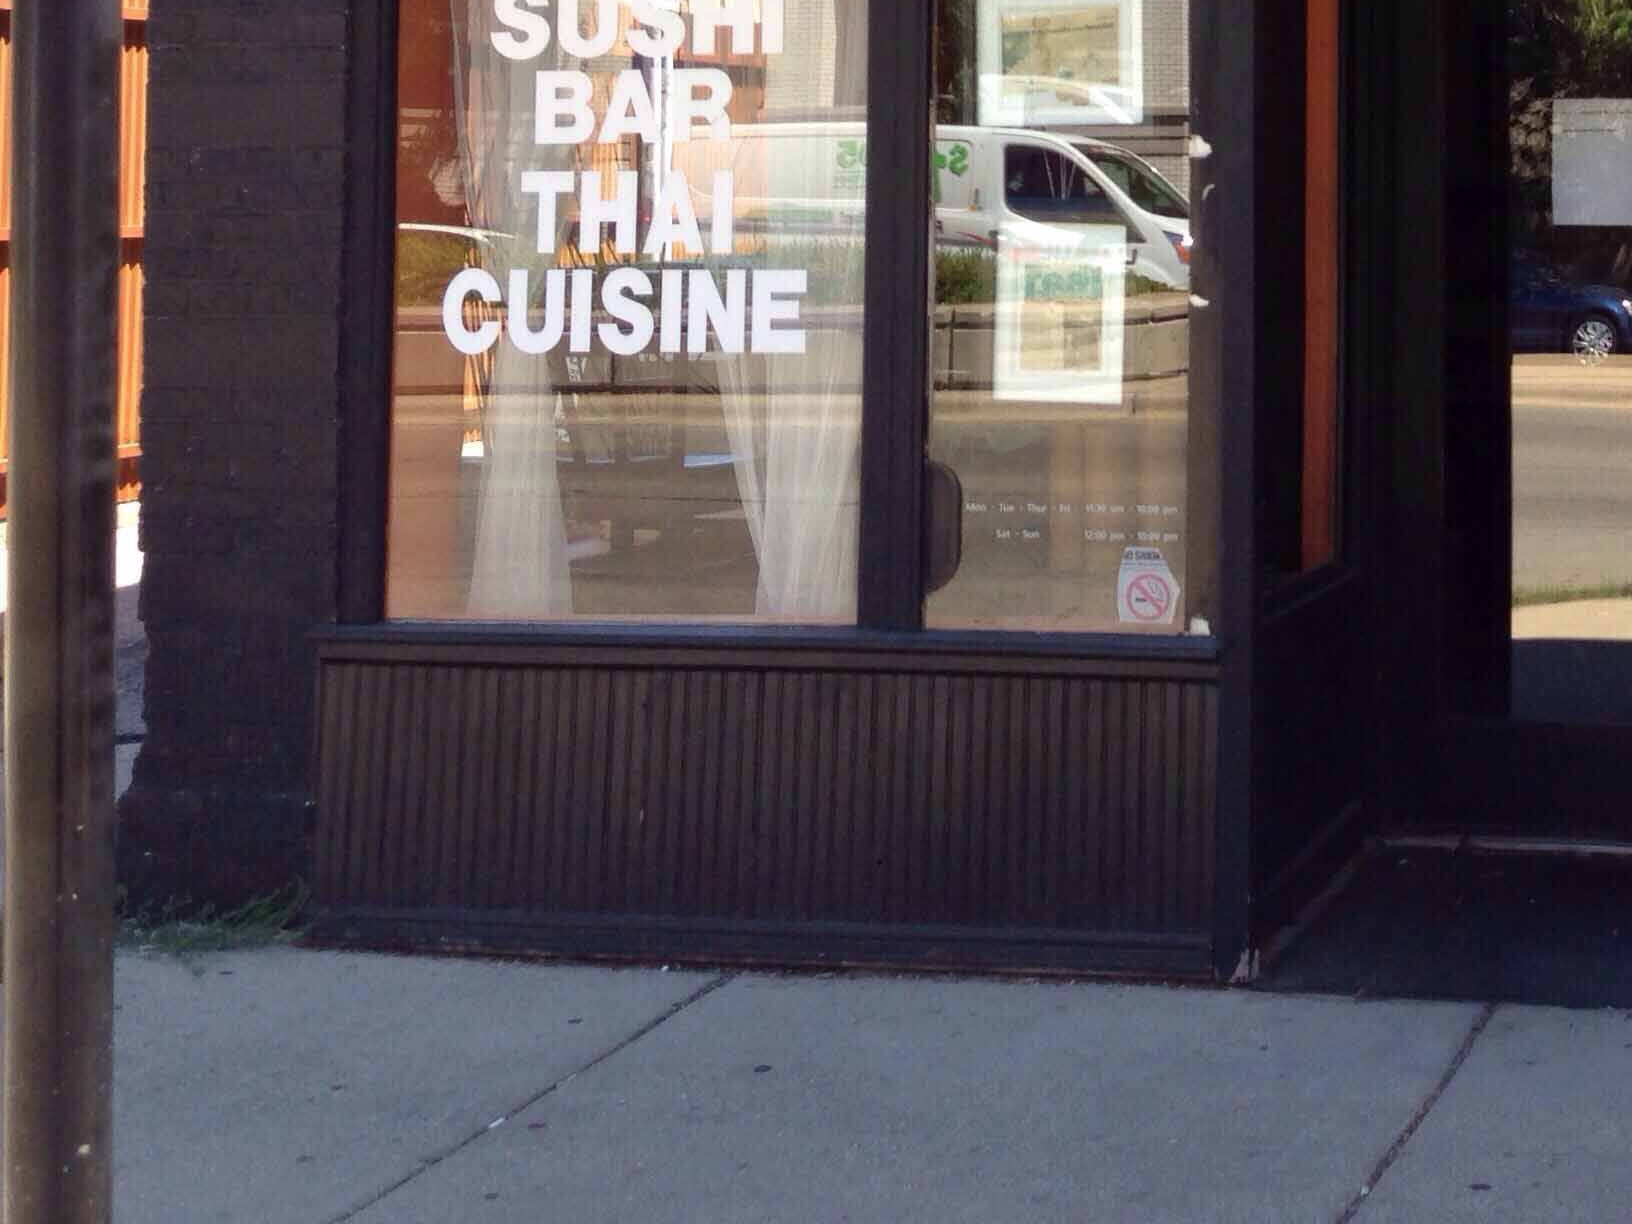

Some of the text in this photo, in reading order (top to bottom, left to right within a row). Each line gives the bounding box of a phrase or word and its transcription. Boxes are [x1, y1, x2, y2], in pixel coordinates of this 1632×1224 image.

[535, 69, 733, 146] BAR
[521, 170, 734, 255] THAI
[442, 267, 808, 356] CUISINE
